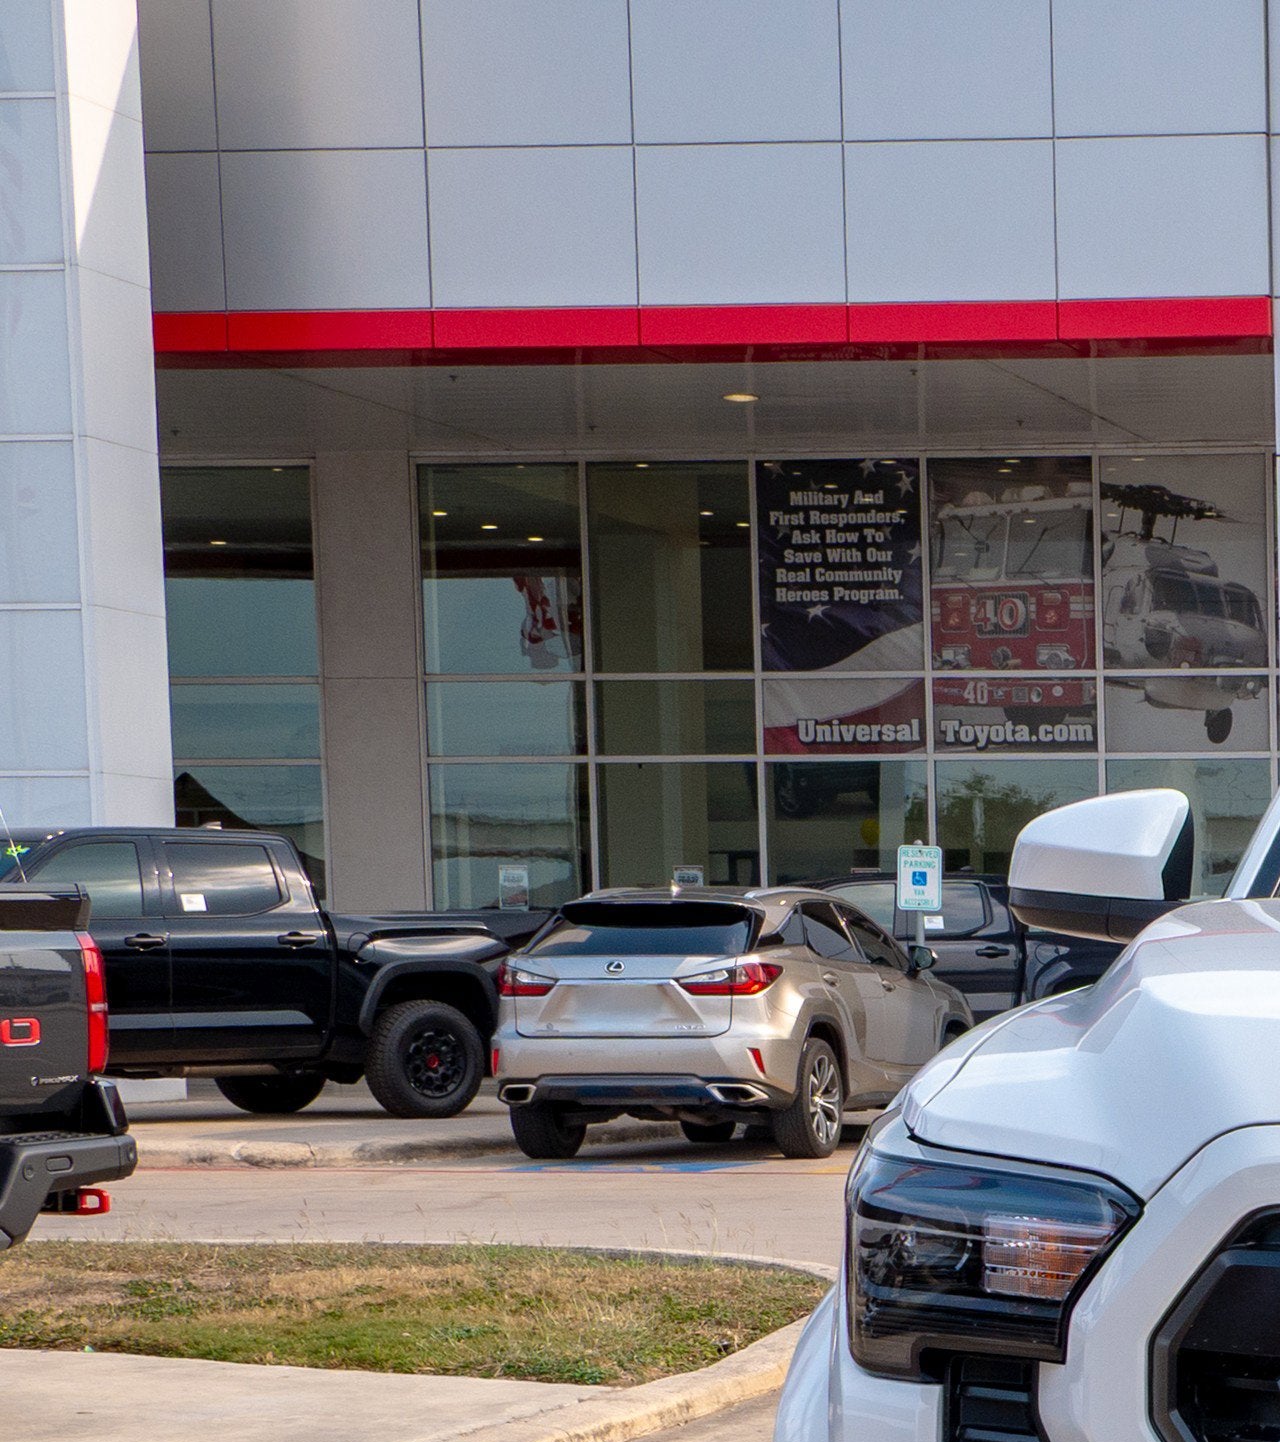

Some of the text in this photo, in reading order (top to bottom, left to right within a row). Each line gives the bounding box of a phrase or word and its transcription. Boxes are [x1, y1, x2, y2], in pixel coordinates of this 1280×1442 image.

[789, 489, 884, 509] Military And
[769, 509, 905, 528] First Responders,
[791, 528, 885, 544] Ask How To
[783, 547, 893, 564] Save With Our
[775, 566, 904, 584] Real Community
[775, 586, 904, 604] Heroes Program.
[971, 597, 1025, 632] 40
[963, 680, 988, 705] 40
[797, 718, 1094, 749] Universal Toyota.com
[902, 849, 939, 858] RESERVED
[903, 861, 936, 869] PARKING
